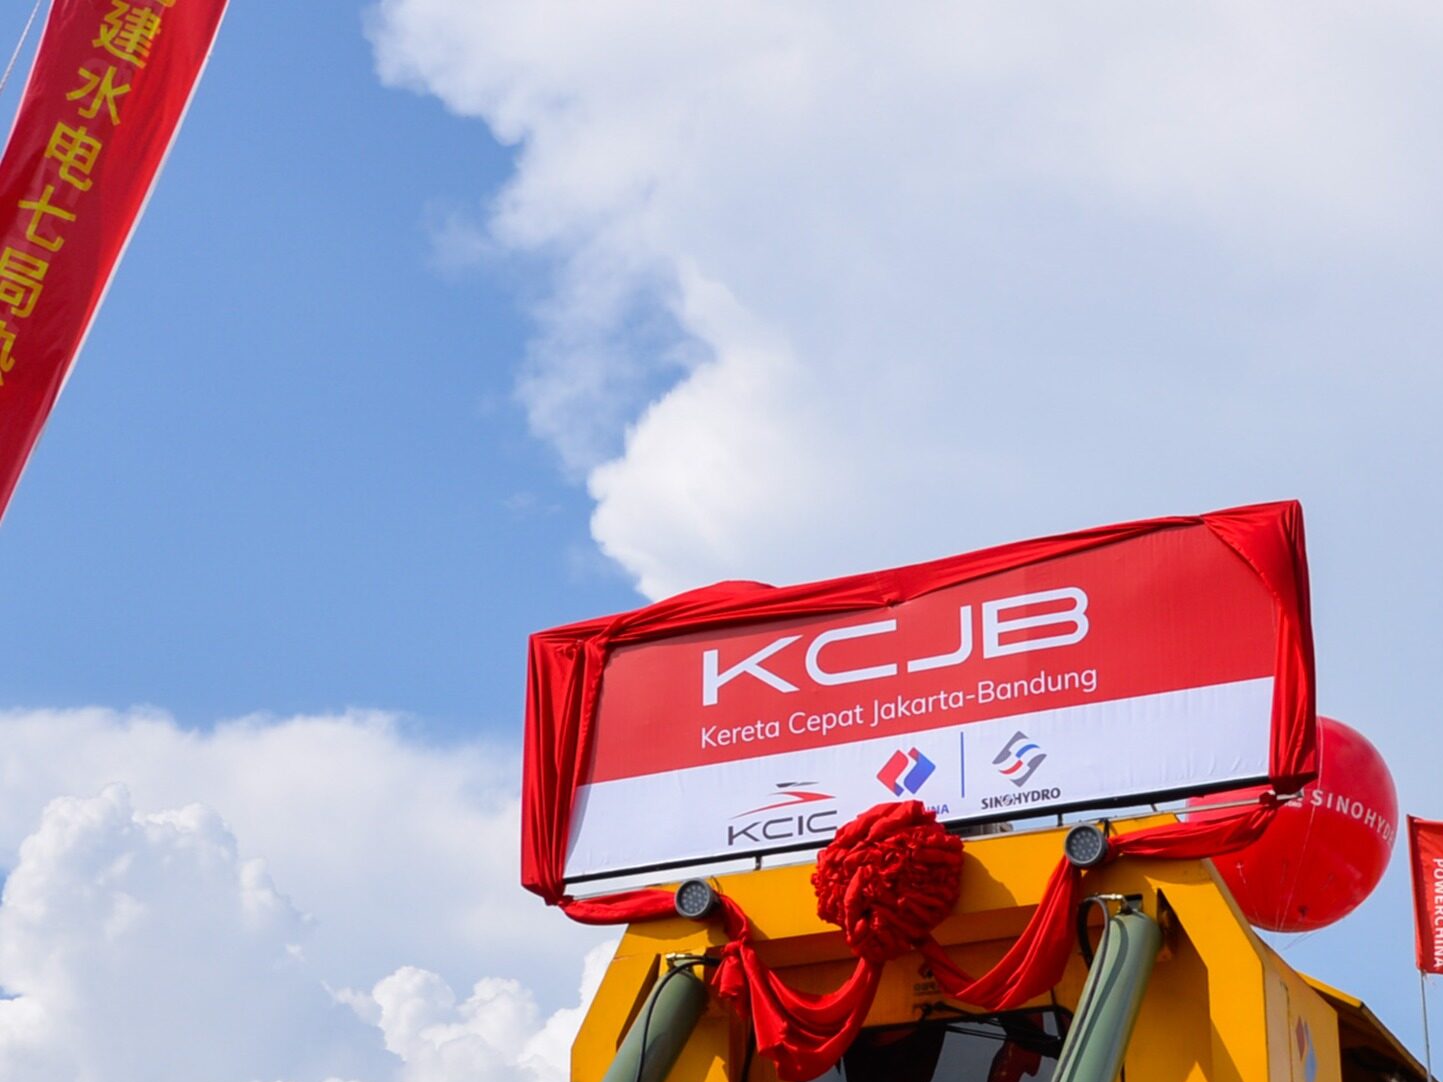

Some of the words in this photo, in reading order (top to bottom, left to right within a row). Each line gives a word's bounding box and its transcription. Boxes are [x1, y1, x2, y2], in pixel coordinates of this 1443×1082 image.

[0, 0, 176, 385] 建水电七局
[701, 585, 1089, 706] KCJB
[701, 719, 781, 748] Kereta
[788, 704, 864, 735] Cepat
[871, 667, 1098, 727] Jakarta-Bandung
[728, 811, 839, 846] KCIC
[981, 787, 1061, 810] SINOHYDRO
